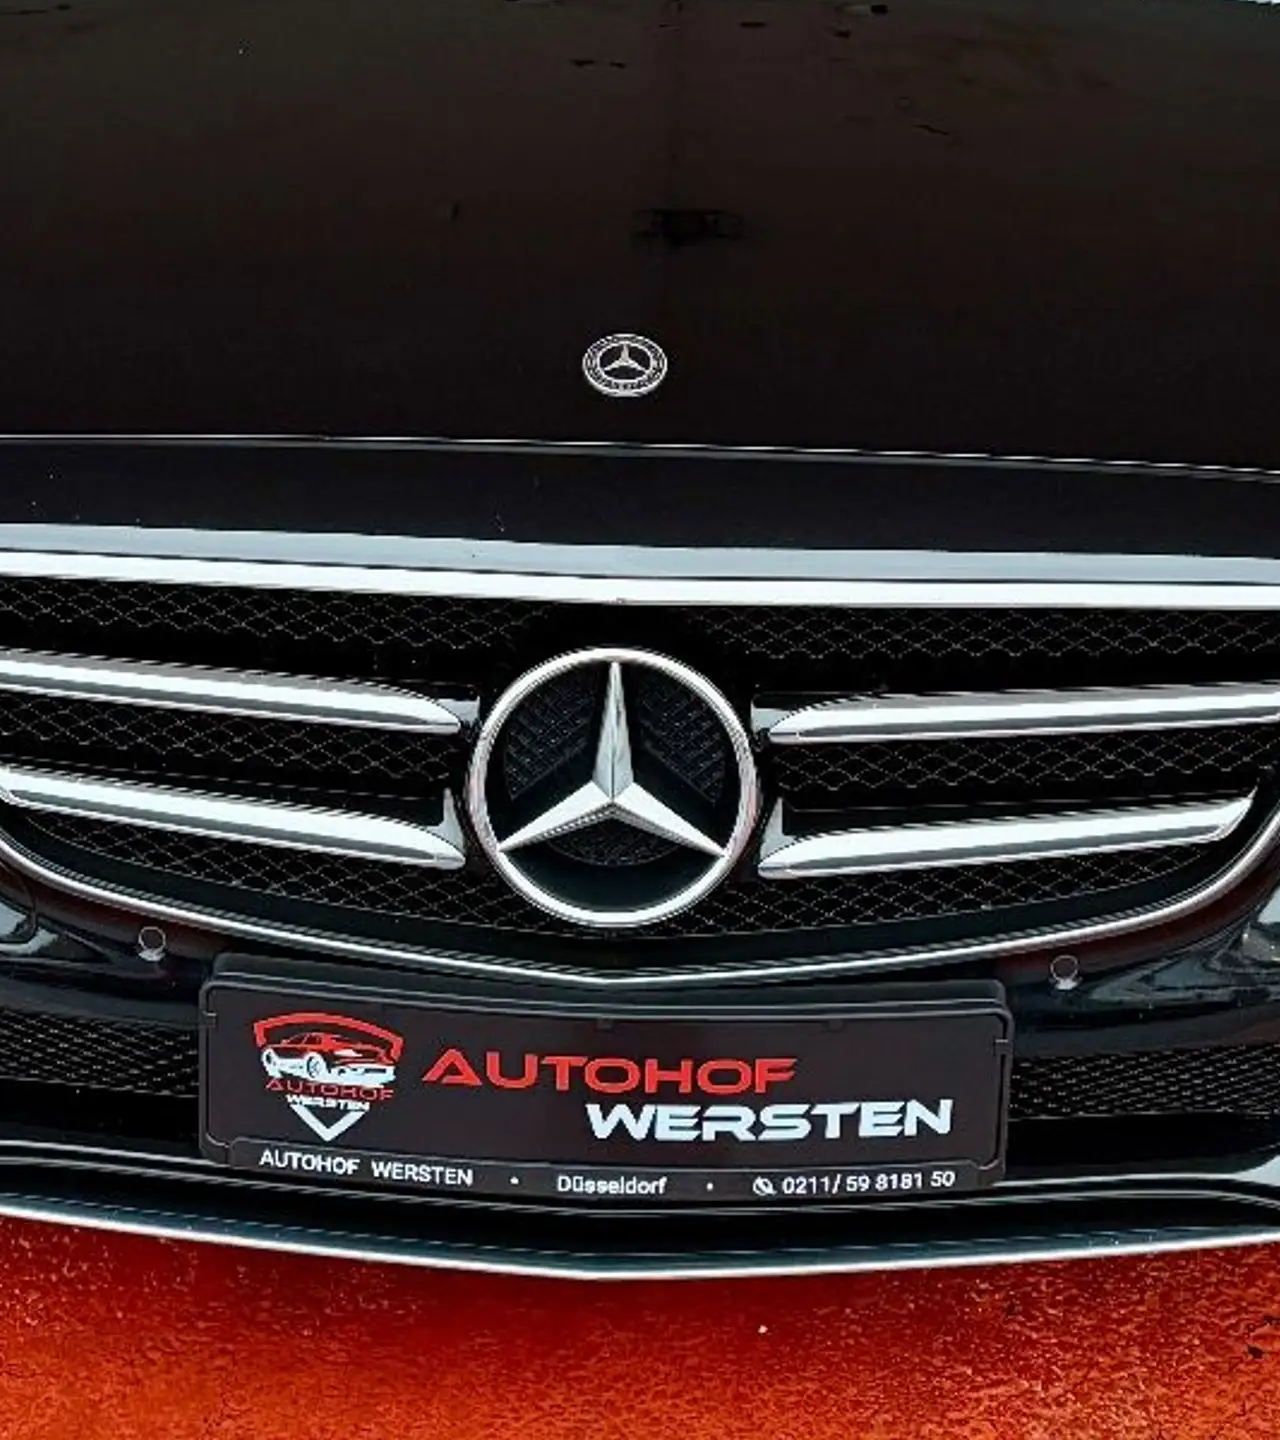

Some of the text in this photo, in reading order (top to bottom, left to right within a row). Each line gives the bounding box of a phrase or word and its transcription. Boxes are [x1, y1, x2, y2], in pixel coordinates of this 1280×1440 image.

[265, 1077, 395, 1102] AUTOHOF
[421, 1047, 798, 1095] AUTOHOF
[286, 1094, 370, 1112] WERSTEN
[585, 1098, 953, 1142] WERSTEN
[259, 1149, 361, 1176] AUTOHOF
[370, 1160, 474, 1187] WERSTEN
[556, 1175, 668, 1196] Düsseldorf
[845, 1175, 871, 1193] 59
[875, 1172, 923, 1192] 8181
[930, 1170, 956, 1189] 50
